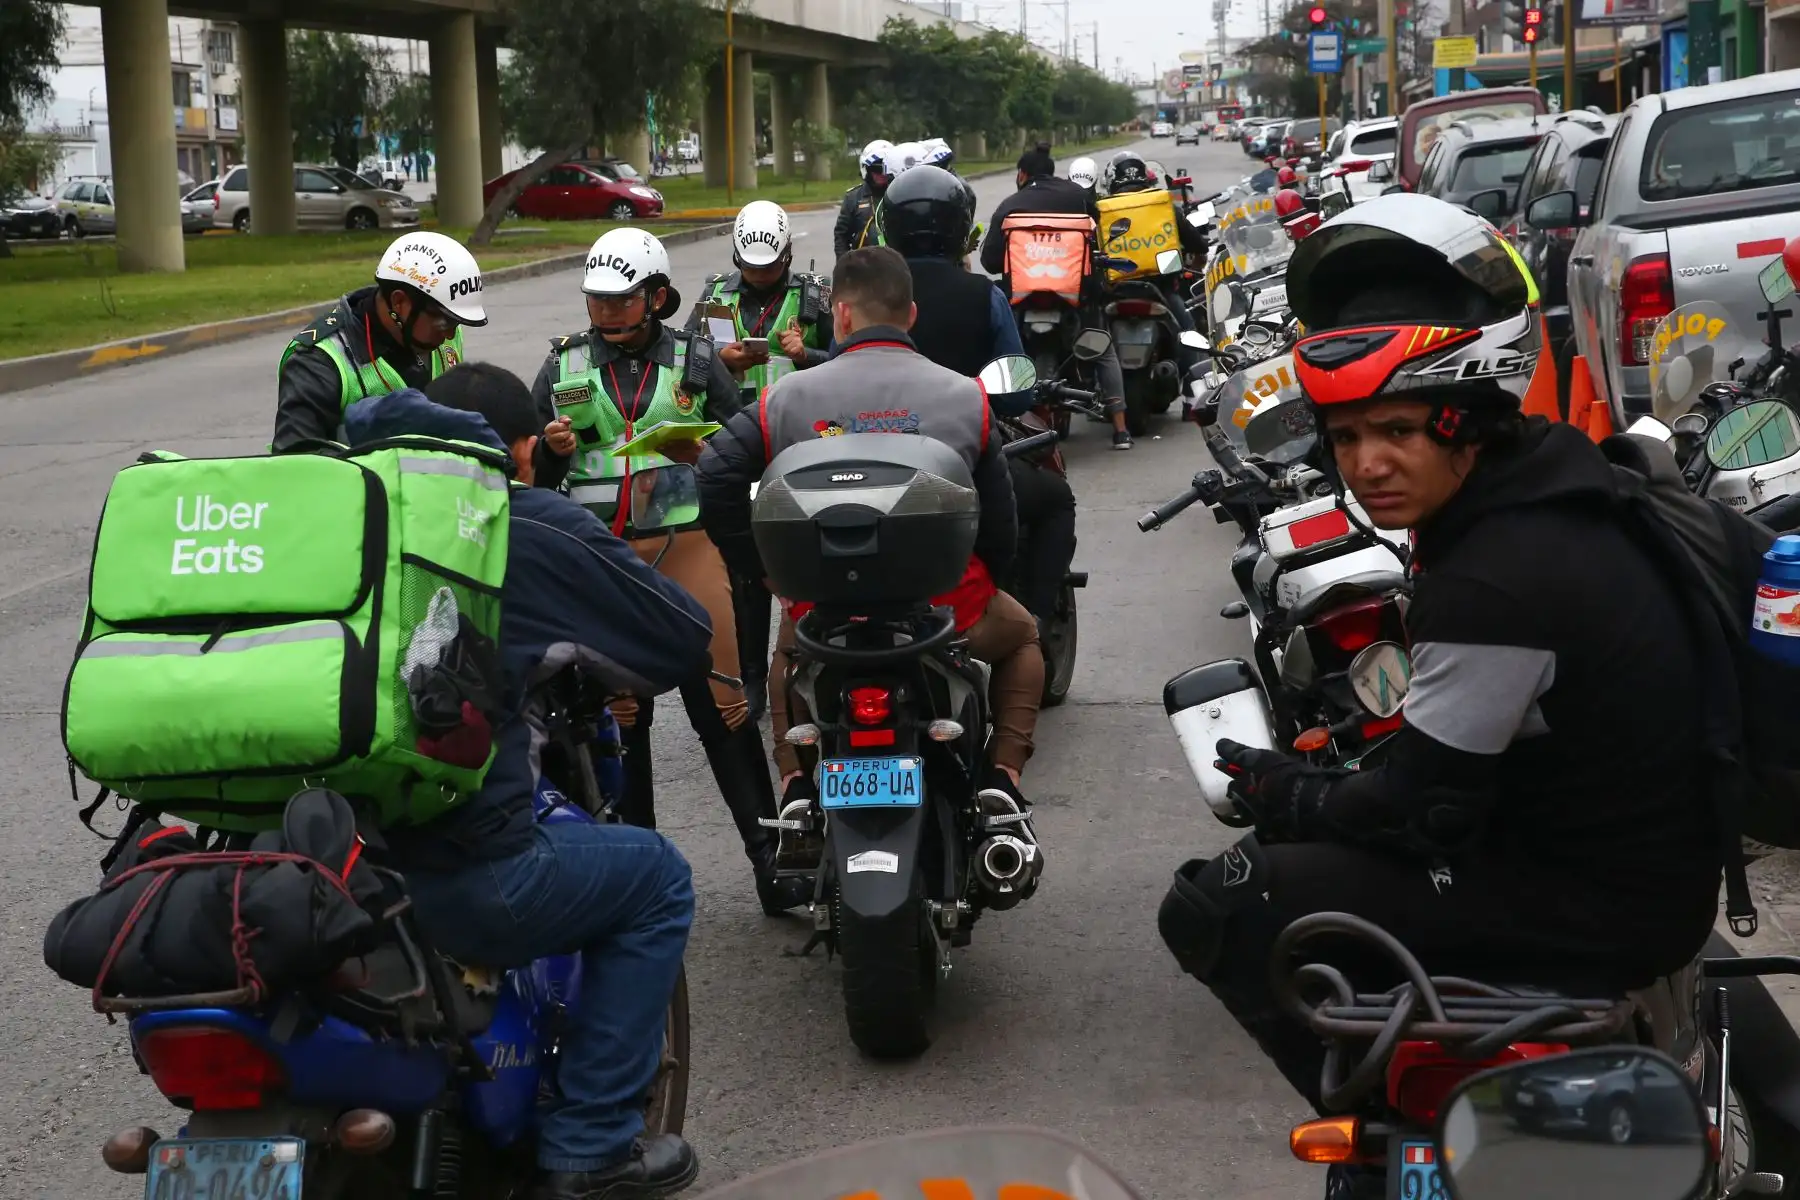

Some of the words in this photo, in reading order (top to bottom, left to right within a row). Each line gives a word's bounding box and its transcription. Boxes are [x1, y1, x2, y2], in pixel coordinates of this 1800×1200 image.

[1072, 173, 1094, 182] POLICIA
[740, 231, 779, 252] POLICIA
[1107, 233, 1166, 254] Glovo
[585, 254, 636, 282] POLICIA
[1677, 263, 1729, 277] TOYOTA
[449, 276, 482, 301] POLI
[858, 408, 909, 421] CHAPAS
[831, 473, 864, 482] SHAD
[176, 494, 269, 532] Uber
[171, 538, 264, 575] Eats
[852, 761, 890, 771] PERU
[827, 772, 915, 798] 0668-UA
[196, 1144, 258, 1164] PERU
